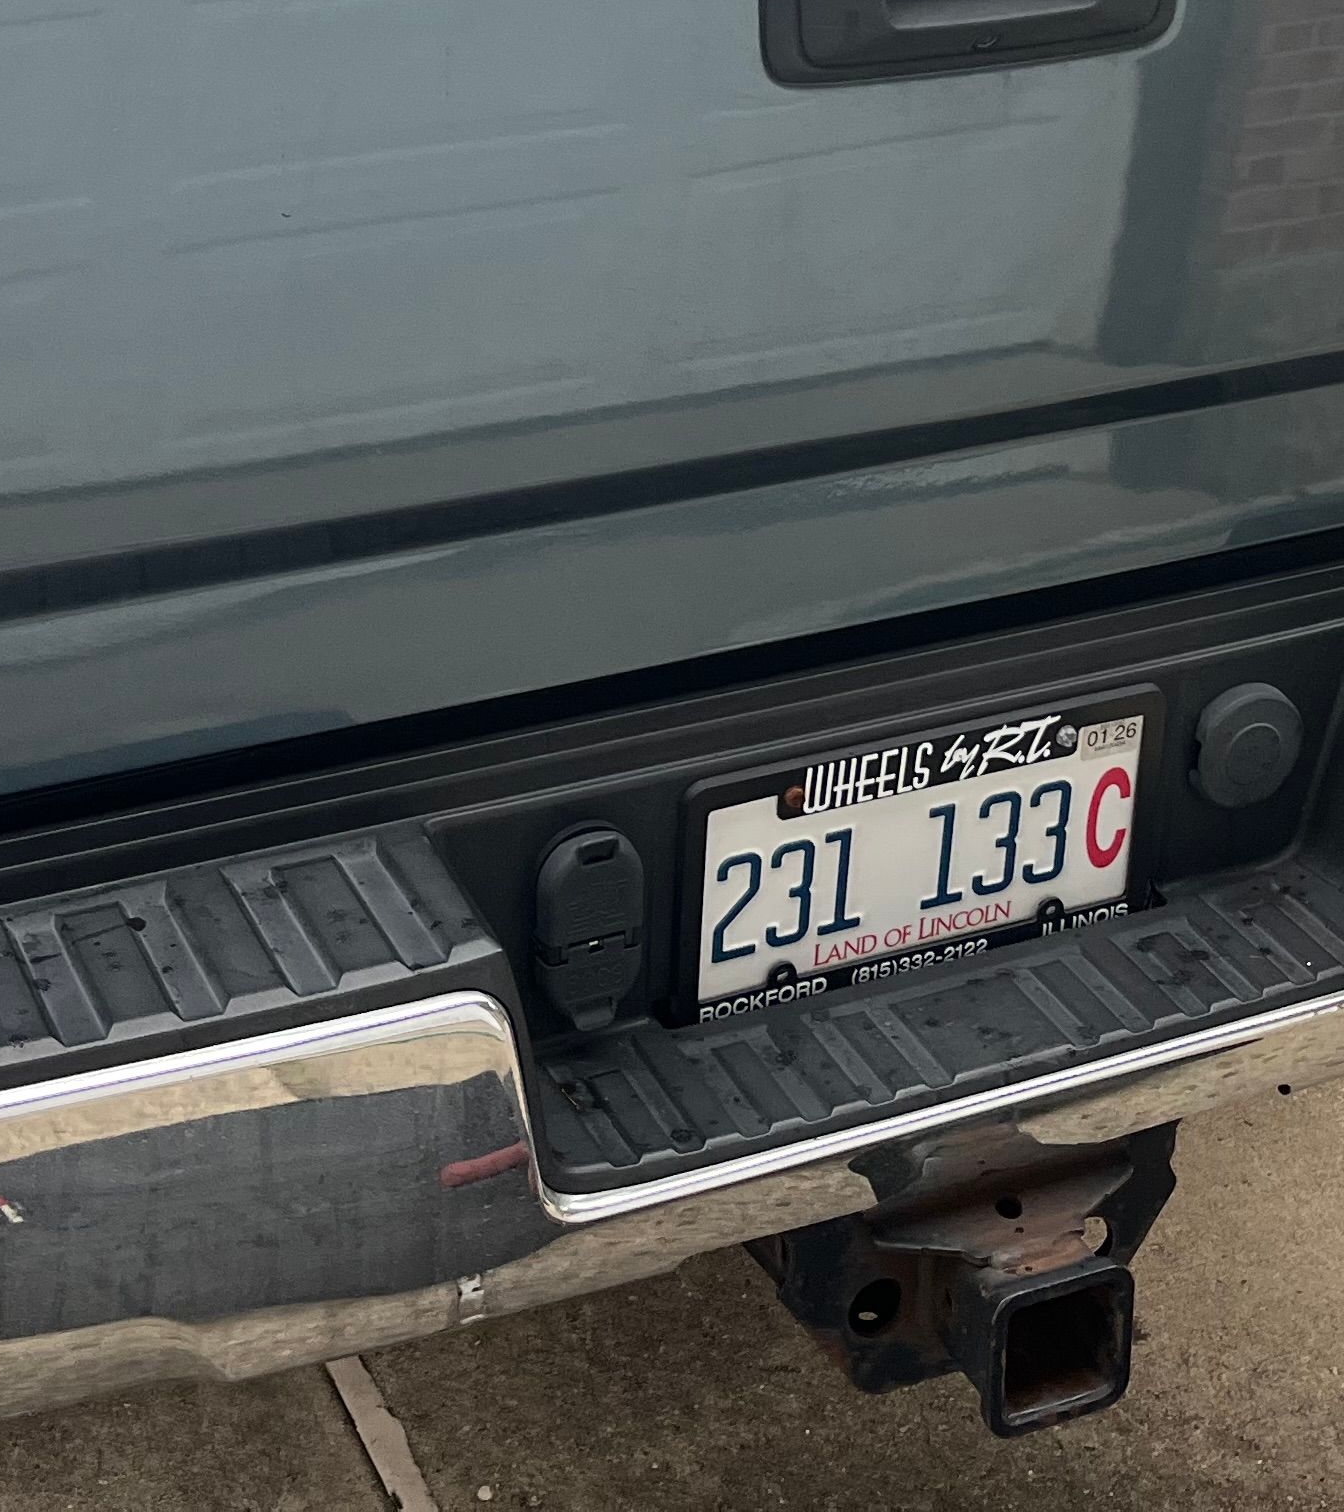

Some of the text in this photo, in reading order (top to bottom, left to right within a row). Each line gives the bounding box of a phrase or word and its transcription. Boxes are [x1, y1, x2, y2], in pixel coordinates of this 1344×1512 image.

[803, 715, 1062, 814] WHEELS by R.T.
[1087, 729, 1108, 747] 01
[1114, 722, 1137, 741] 26
[711, 828, 860, 964] 231
[920, 780, 1073, 910] 133
[1085, 766, 1131, 869] C
[699, 902, 1129, 1024] ROCKFORD (815)332-2122 ILLINOIS
[813, 900, 1012, 966] LAND OF LINCOLN
